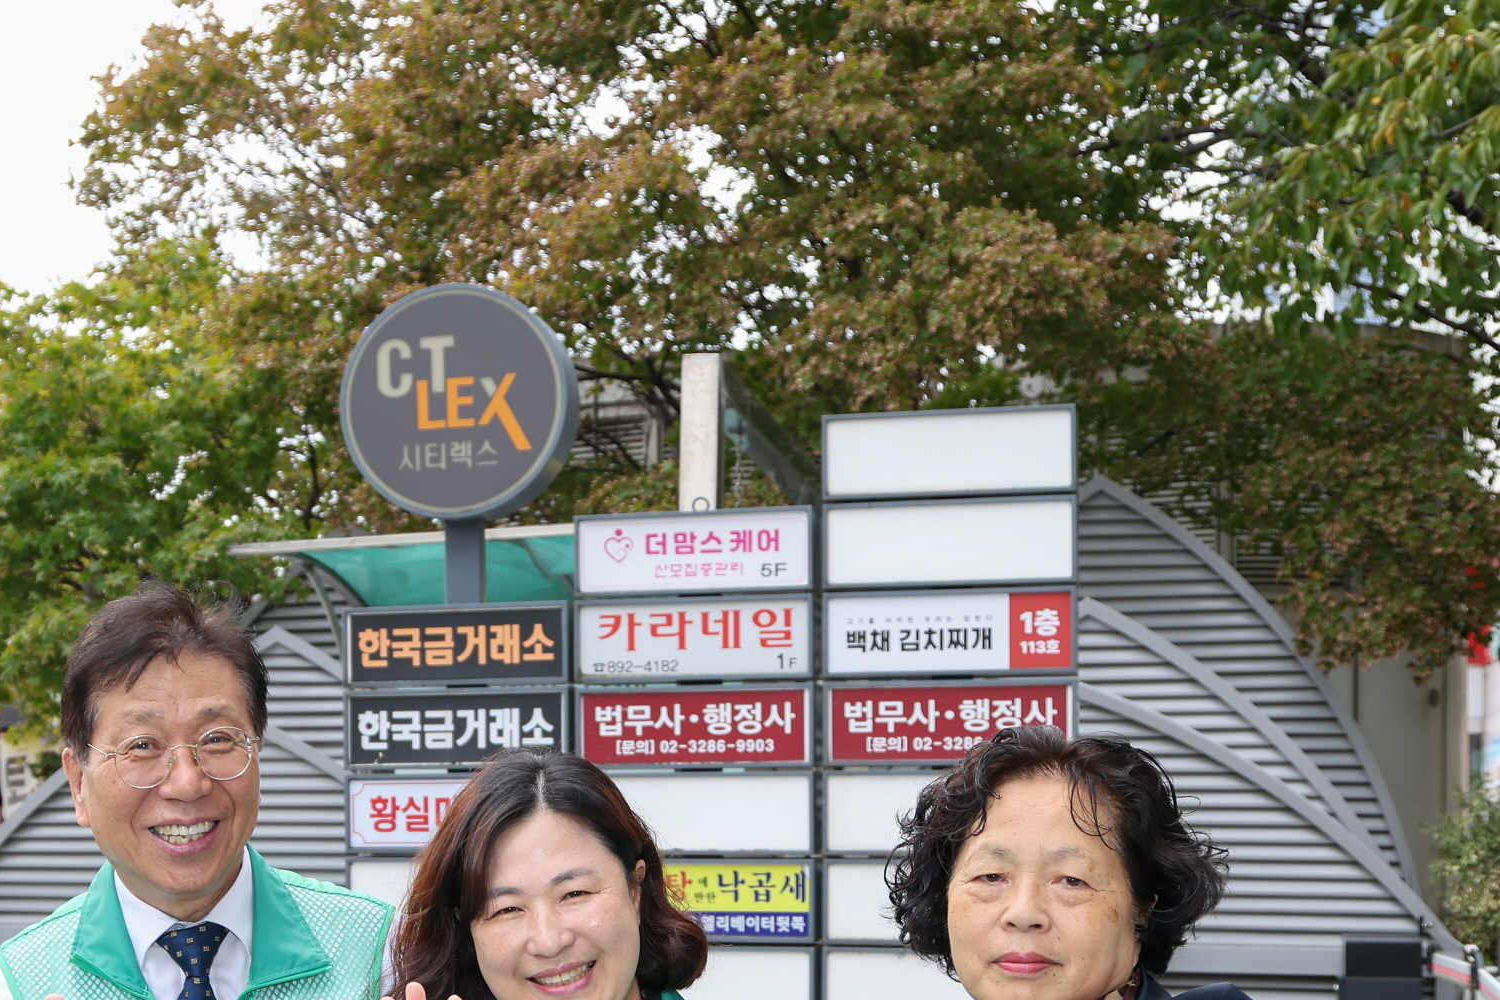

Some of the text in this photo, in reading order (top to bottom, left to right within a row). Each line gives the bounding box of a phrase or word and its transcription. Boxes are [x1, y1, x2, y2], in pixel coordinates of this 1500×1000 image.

[399, 438, 499, 472] 시티렉스
[645, 528, 781, 556] 더맘스케어
[654, 562, 788, 578] 산모집중관리 5F
[598, 608, 794, 651] 카라네일
[1019, 608, 1062, 636] 1층
[358, 623, 555, 668] 한국금거래소
[846, 627, 993, 652] 백채 김치찌개
[1019, 638, 1061, 655] 113호
[607, 660, 679, 673] 892-4182
[776, 653, 798, 669] 1F
[358, 707, 555, 750] 한국금거래소
[594, 701, 797, 737] 법무사·행정사
[615, 738, 775, 755] [문의] 02-3286-9903
[866, 737, 908, 753] [문의]
[717, 871, 808, 903] 낙곱새
